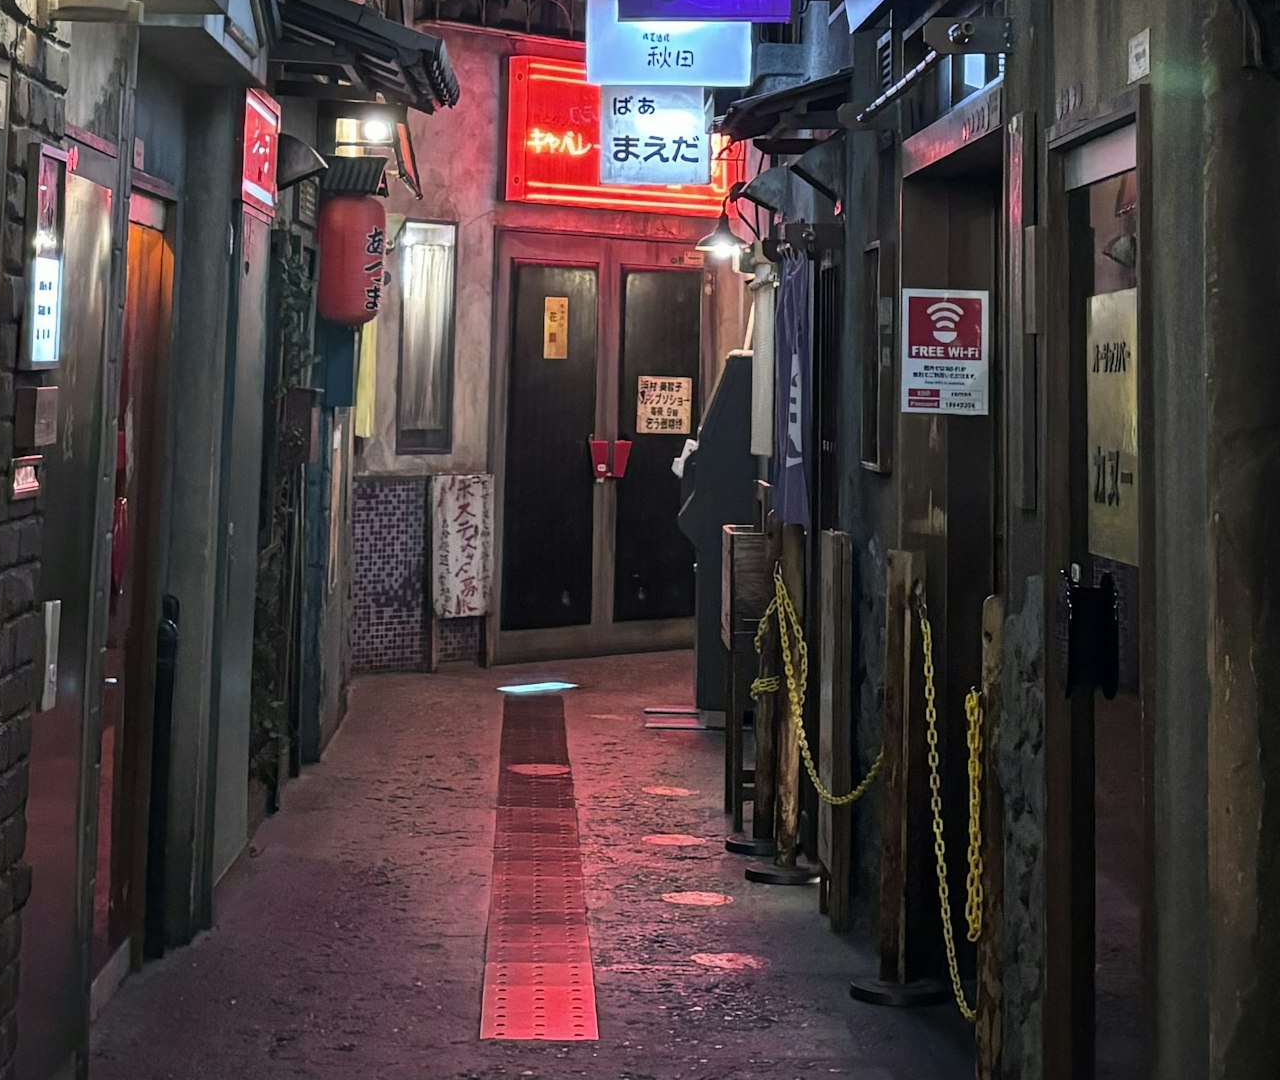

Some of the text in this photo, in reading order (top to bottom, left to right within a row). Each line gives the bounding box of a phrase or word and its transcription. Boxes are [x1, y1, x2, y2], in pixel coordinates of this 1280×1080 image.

[647, 45, 695, 69] 秋田
[613, 96, 655, 116] ばあ
[613, 135, 700, 163] まえだ
[911, 345, 979, 359] FREE Wi-Fi
